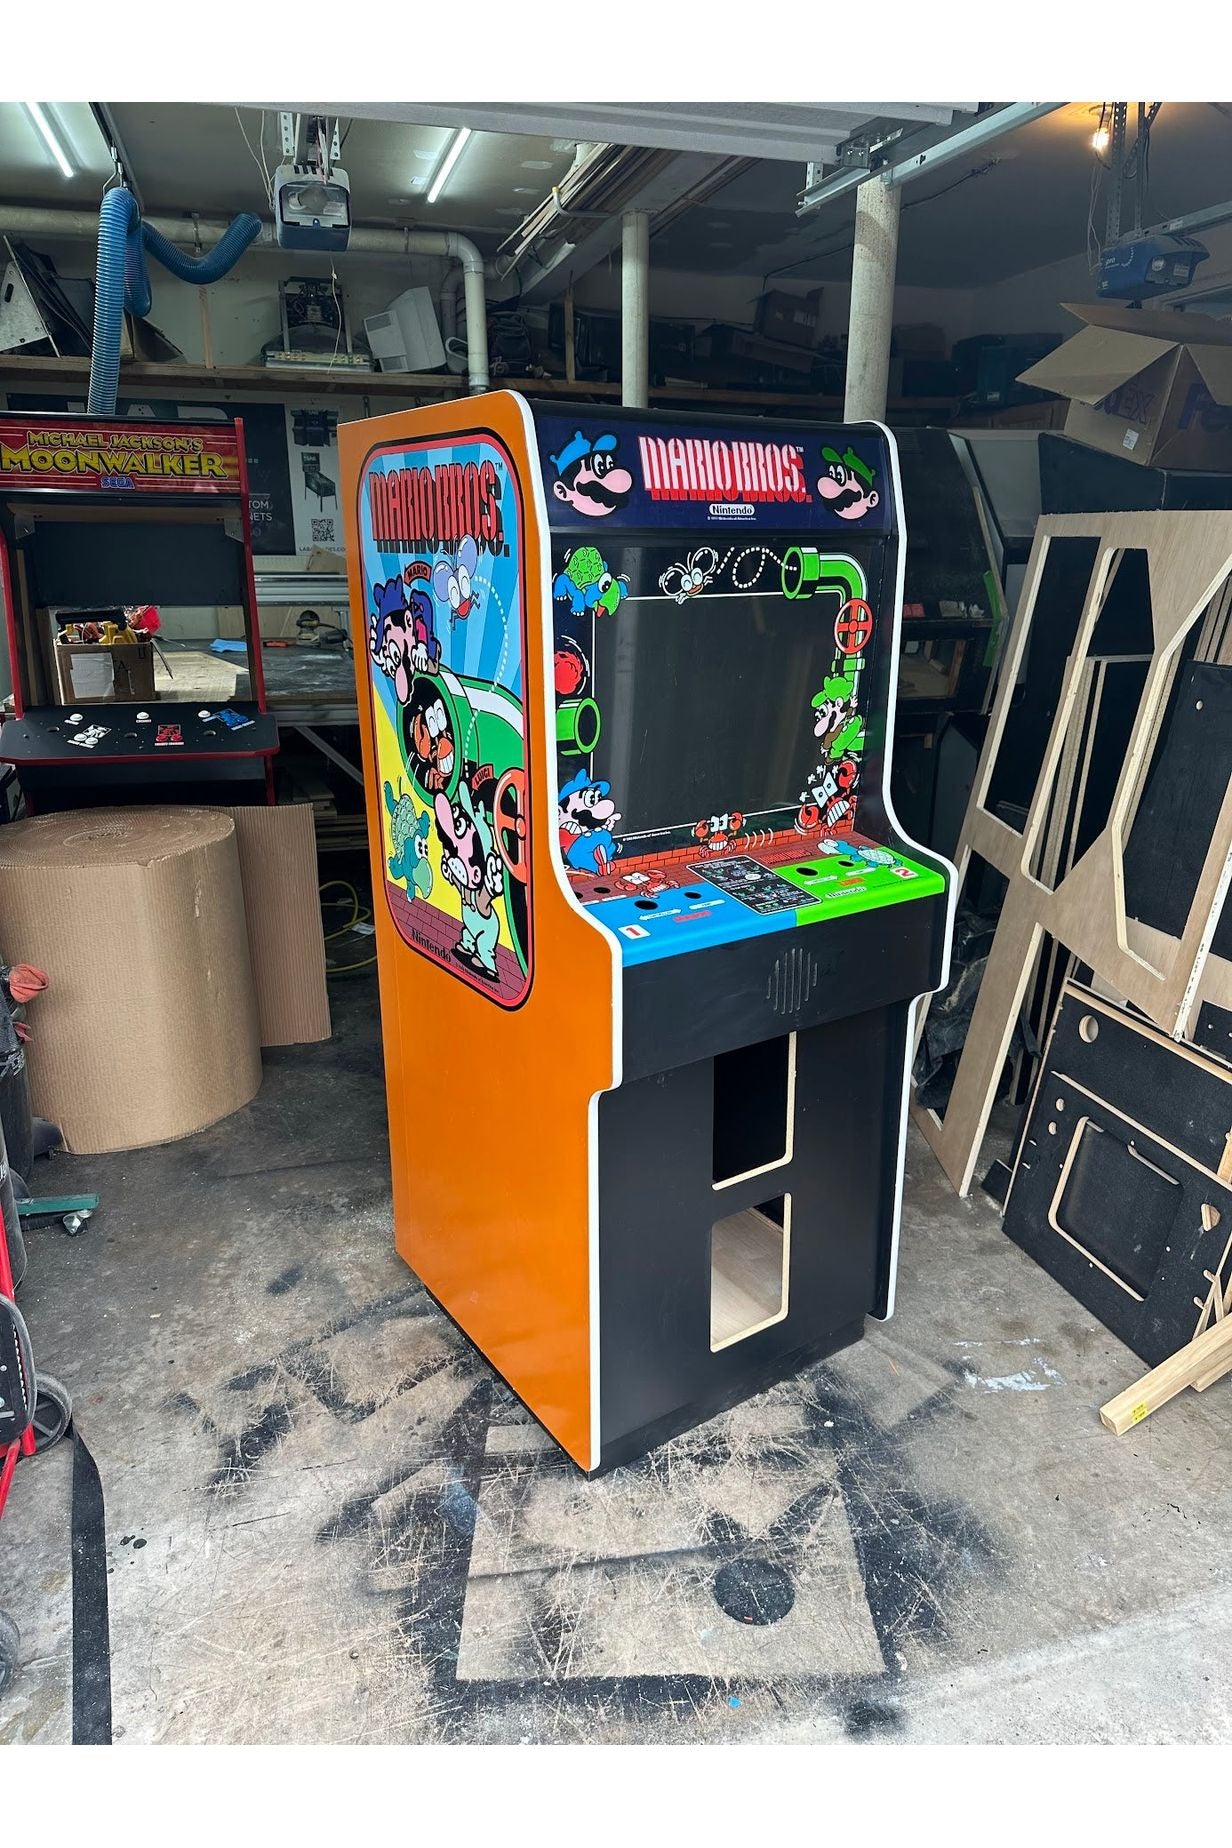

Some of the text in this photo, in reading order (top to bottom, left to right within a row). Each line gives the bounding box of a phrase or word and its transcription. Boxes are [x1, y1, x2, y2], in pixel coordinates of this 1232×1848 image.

[28, 431, 204, 453] MICHAEL JACKSON'S
[0, 441, 228, 479] MOONWALKER
[638, 436, 738, 501] MARIO
[732, 441, 813, 502] BROS.
[101, 477, 135, 489] SEGA
[369, 464, 439, 554] MARIO
[435, 459, 510, 557] BROS.
[711, 504, 754, 515] Nintendo
[407, 565, 429, 578] MARIO
[474, 767, 491, 787] LUIGI
[894, 868, 915, 878] 2
[626, 927, 641, 937] 1
[411, 927, 452, 962] Nintendo
